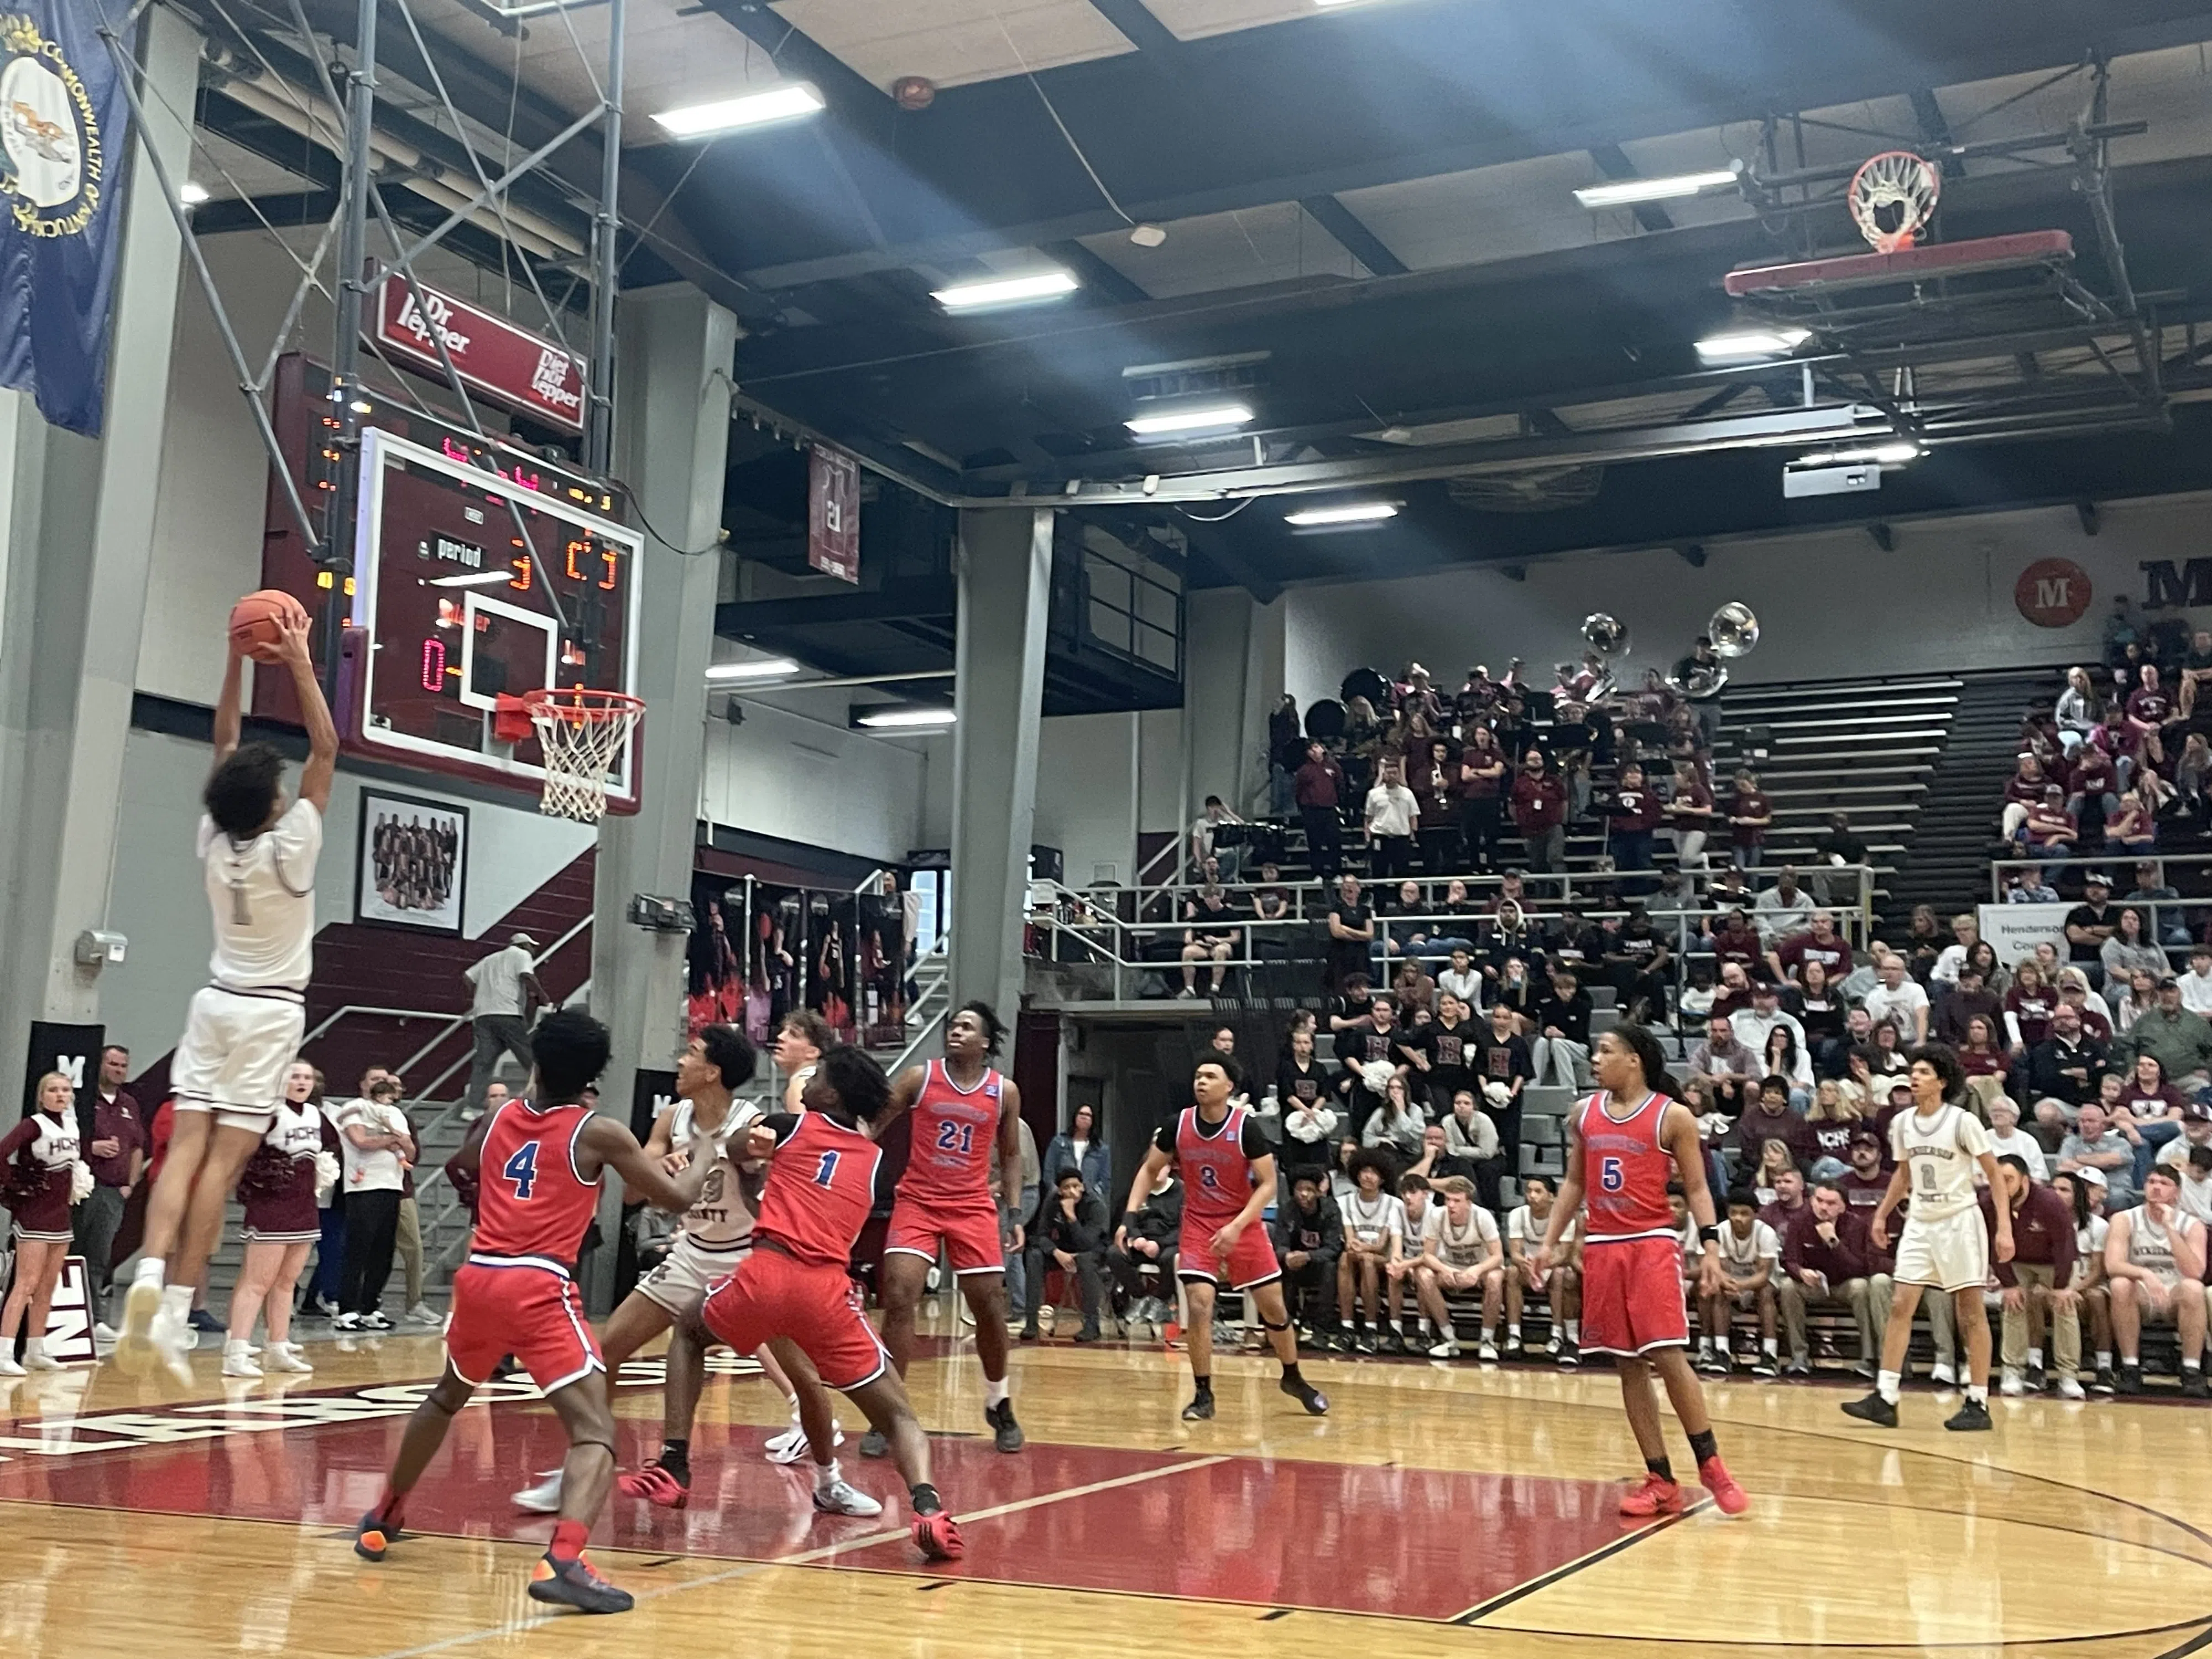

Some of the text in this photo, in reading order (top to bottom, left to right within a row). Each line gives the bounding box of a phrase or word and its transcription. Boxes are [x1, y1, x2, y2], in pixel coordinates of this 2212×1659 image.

[426, 295, 453, 325] Dr
[540, 349, 569, 376] Diet
[827, 500, 841, 533] 21
[437, 539, 481, 568] period
[2034, 578, 2071, 608] M
[57, 1055, 86, 1089] M
[936, 1119, 973, 1154] 21
[503, 1141, 540, 1201] 4
[811, 1150, 841, 1190] 1
[1601, 1157, 1625, 1192] 5
[1921, 1164, 1937, 1190] 2
